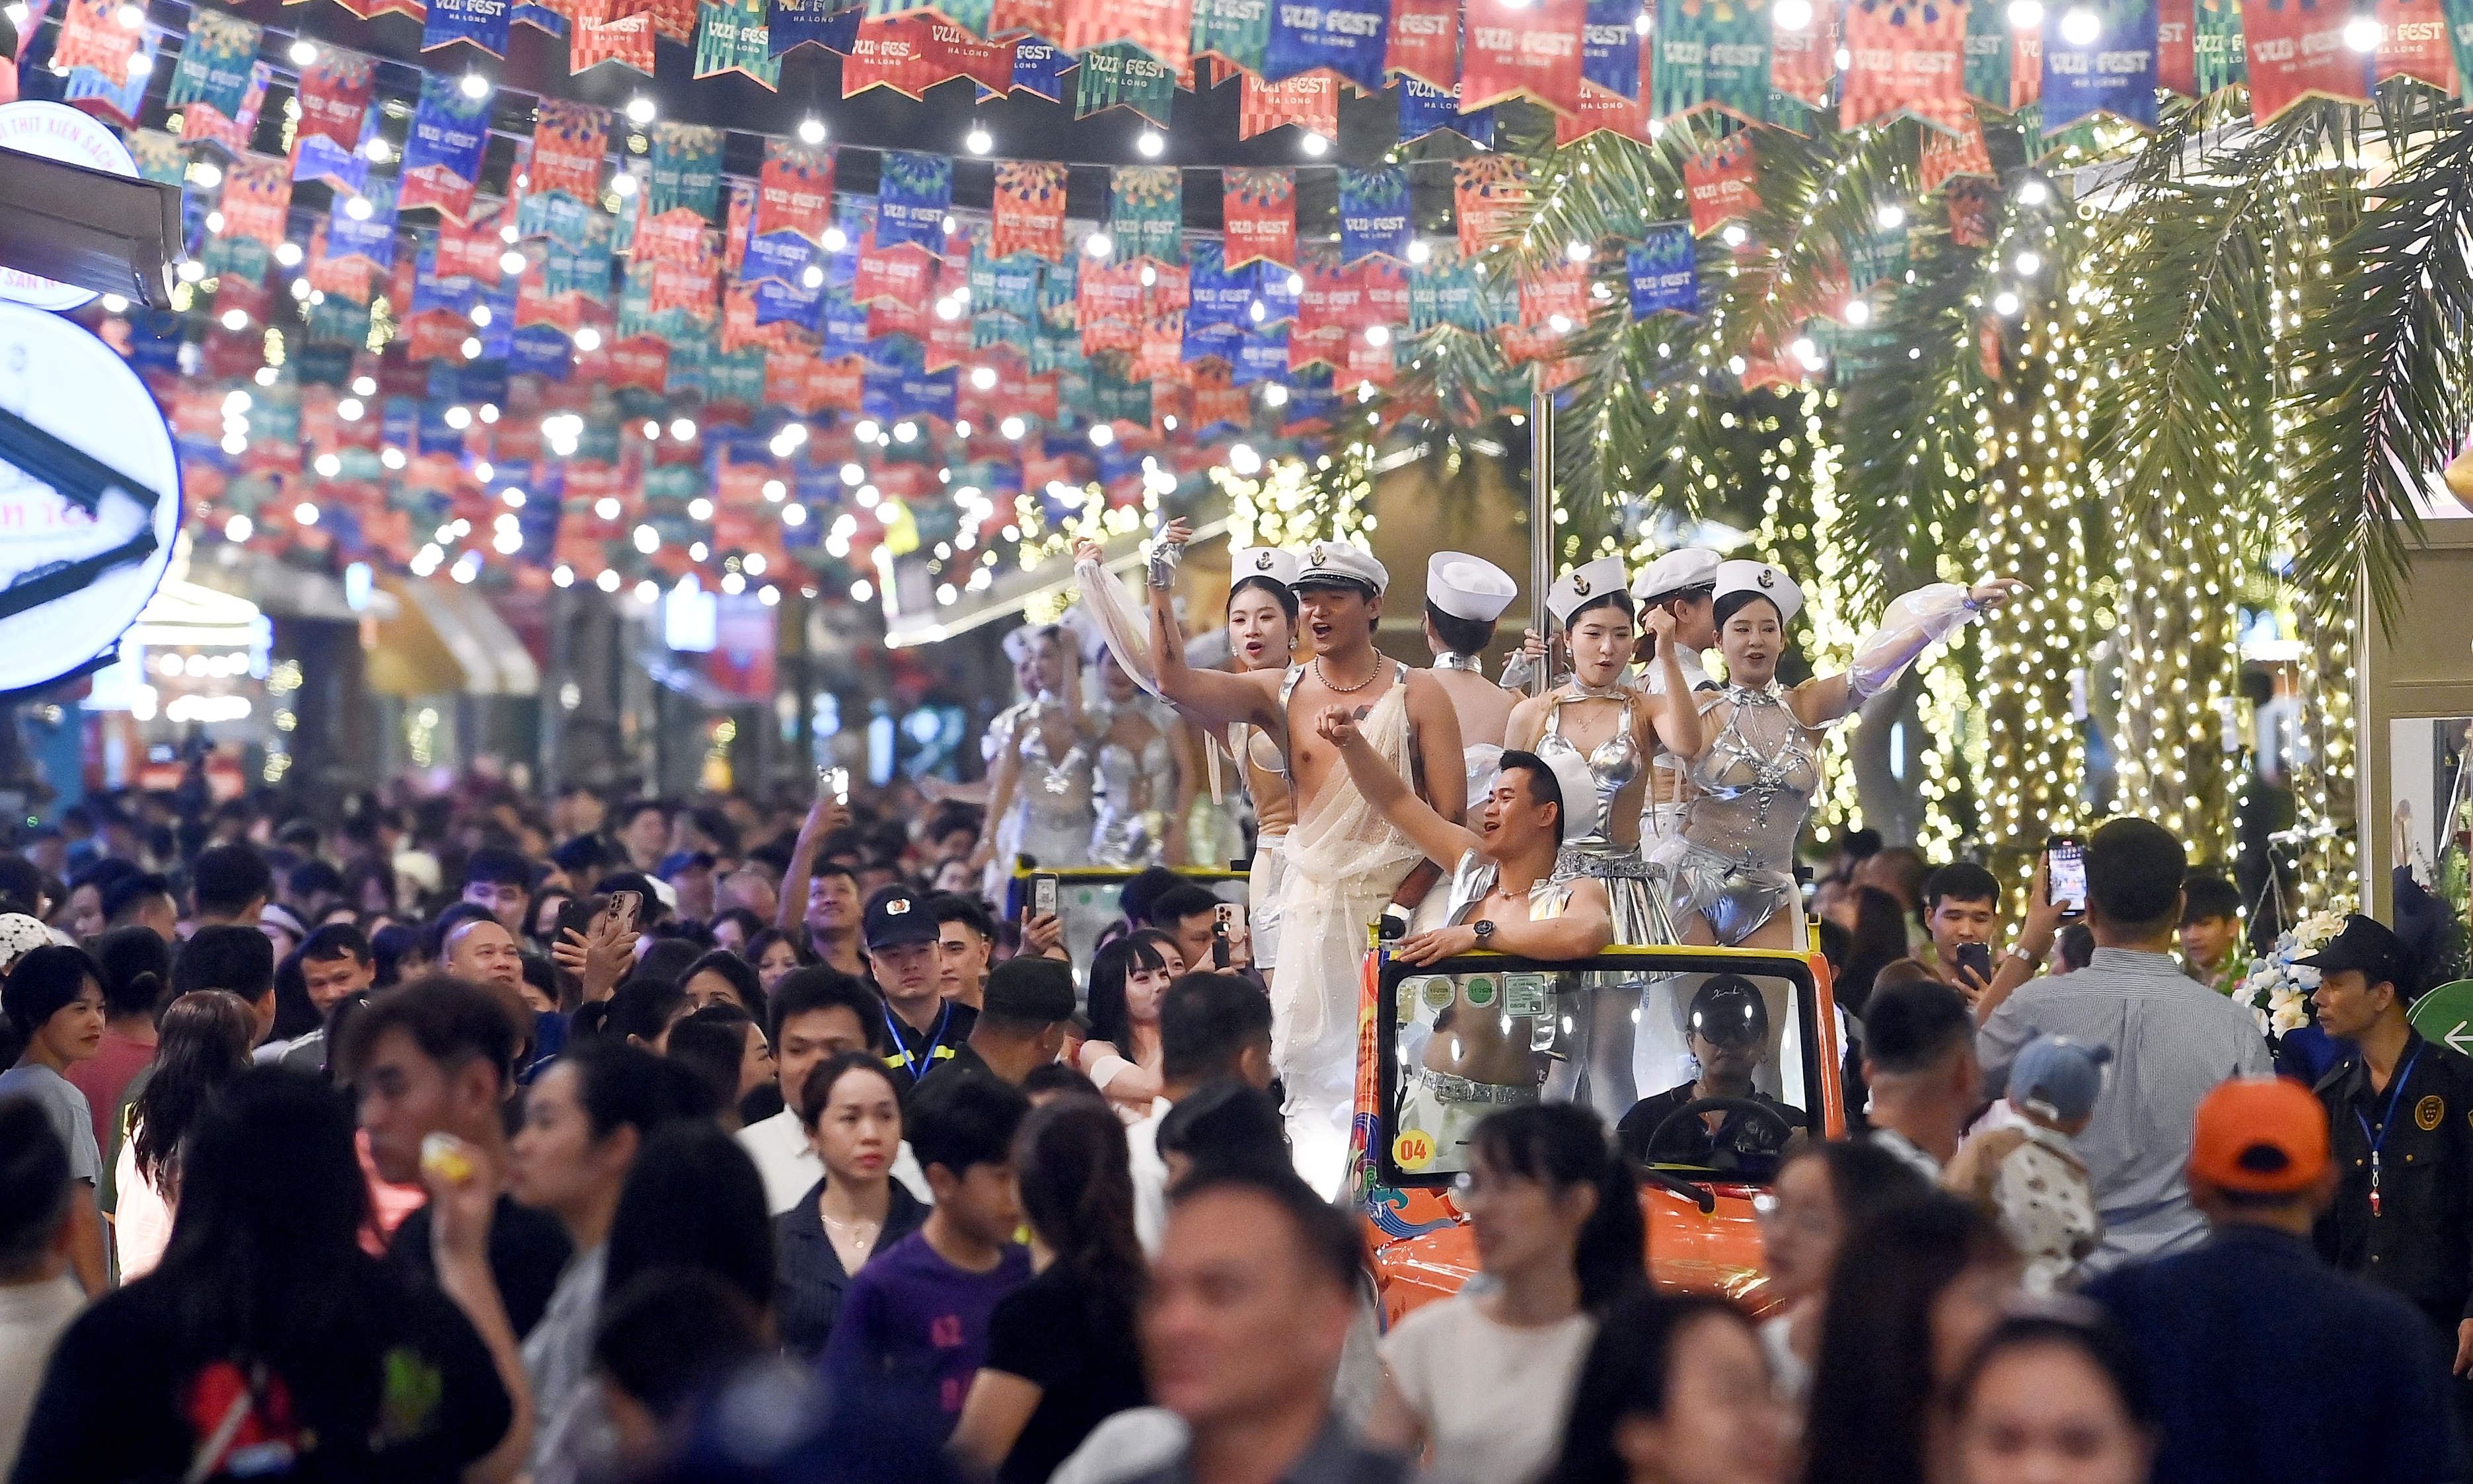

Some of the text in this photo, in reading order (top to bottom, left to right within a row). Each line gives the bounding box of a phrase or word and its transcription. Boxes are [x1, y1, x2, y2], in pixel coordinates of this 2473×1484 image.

[466, 0, 506, 17] FEST
[612, 18, 649, 32] FEST
[1325, 9, 1382, 37] FEST
[1399, 13, 1450, 35] FEST
[2158, 22, 2186, 42] ST
[2396, 22, 2444, 41] FEST
[708, 22, 768, 44] VUI FES
[932, 25, 961, 43] VUI
[881, 41, 910, 56] FES
[963, 49, 989, 57] LONG
[1017, 46, 1054, 59] FEST
[1089, 54, 1169, 78] VUI FEST
[1287, 77, 1331, 93] FEST
[1407, 80, 1436, 98] VUI
[1401, 1139, 1426, 1161] 04
